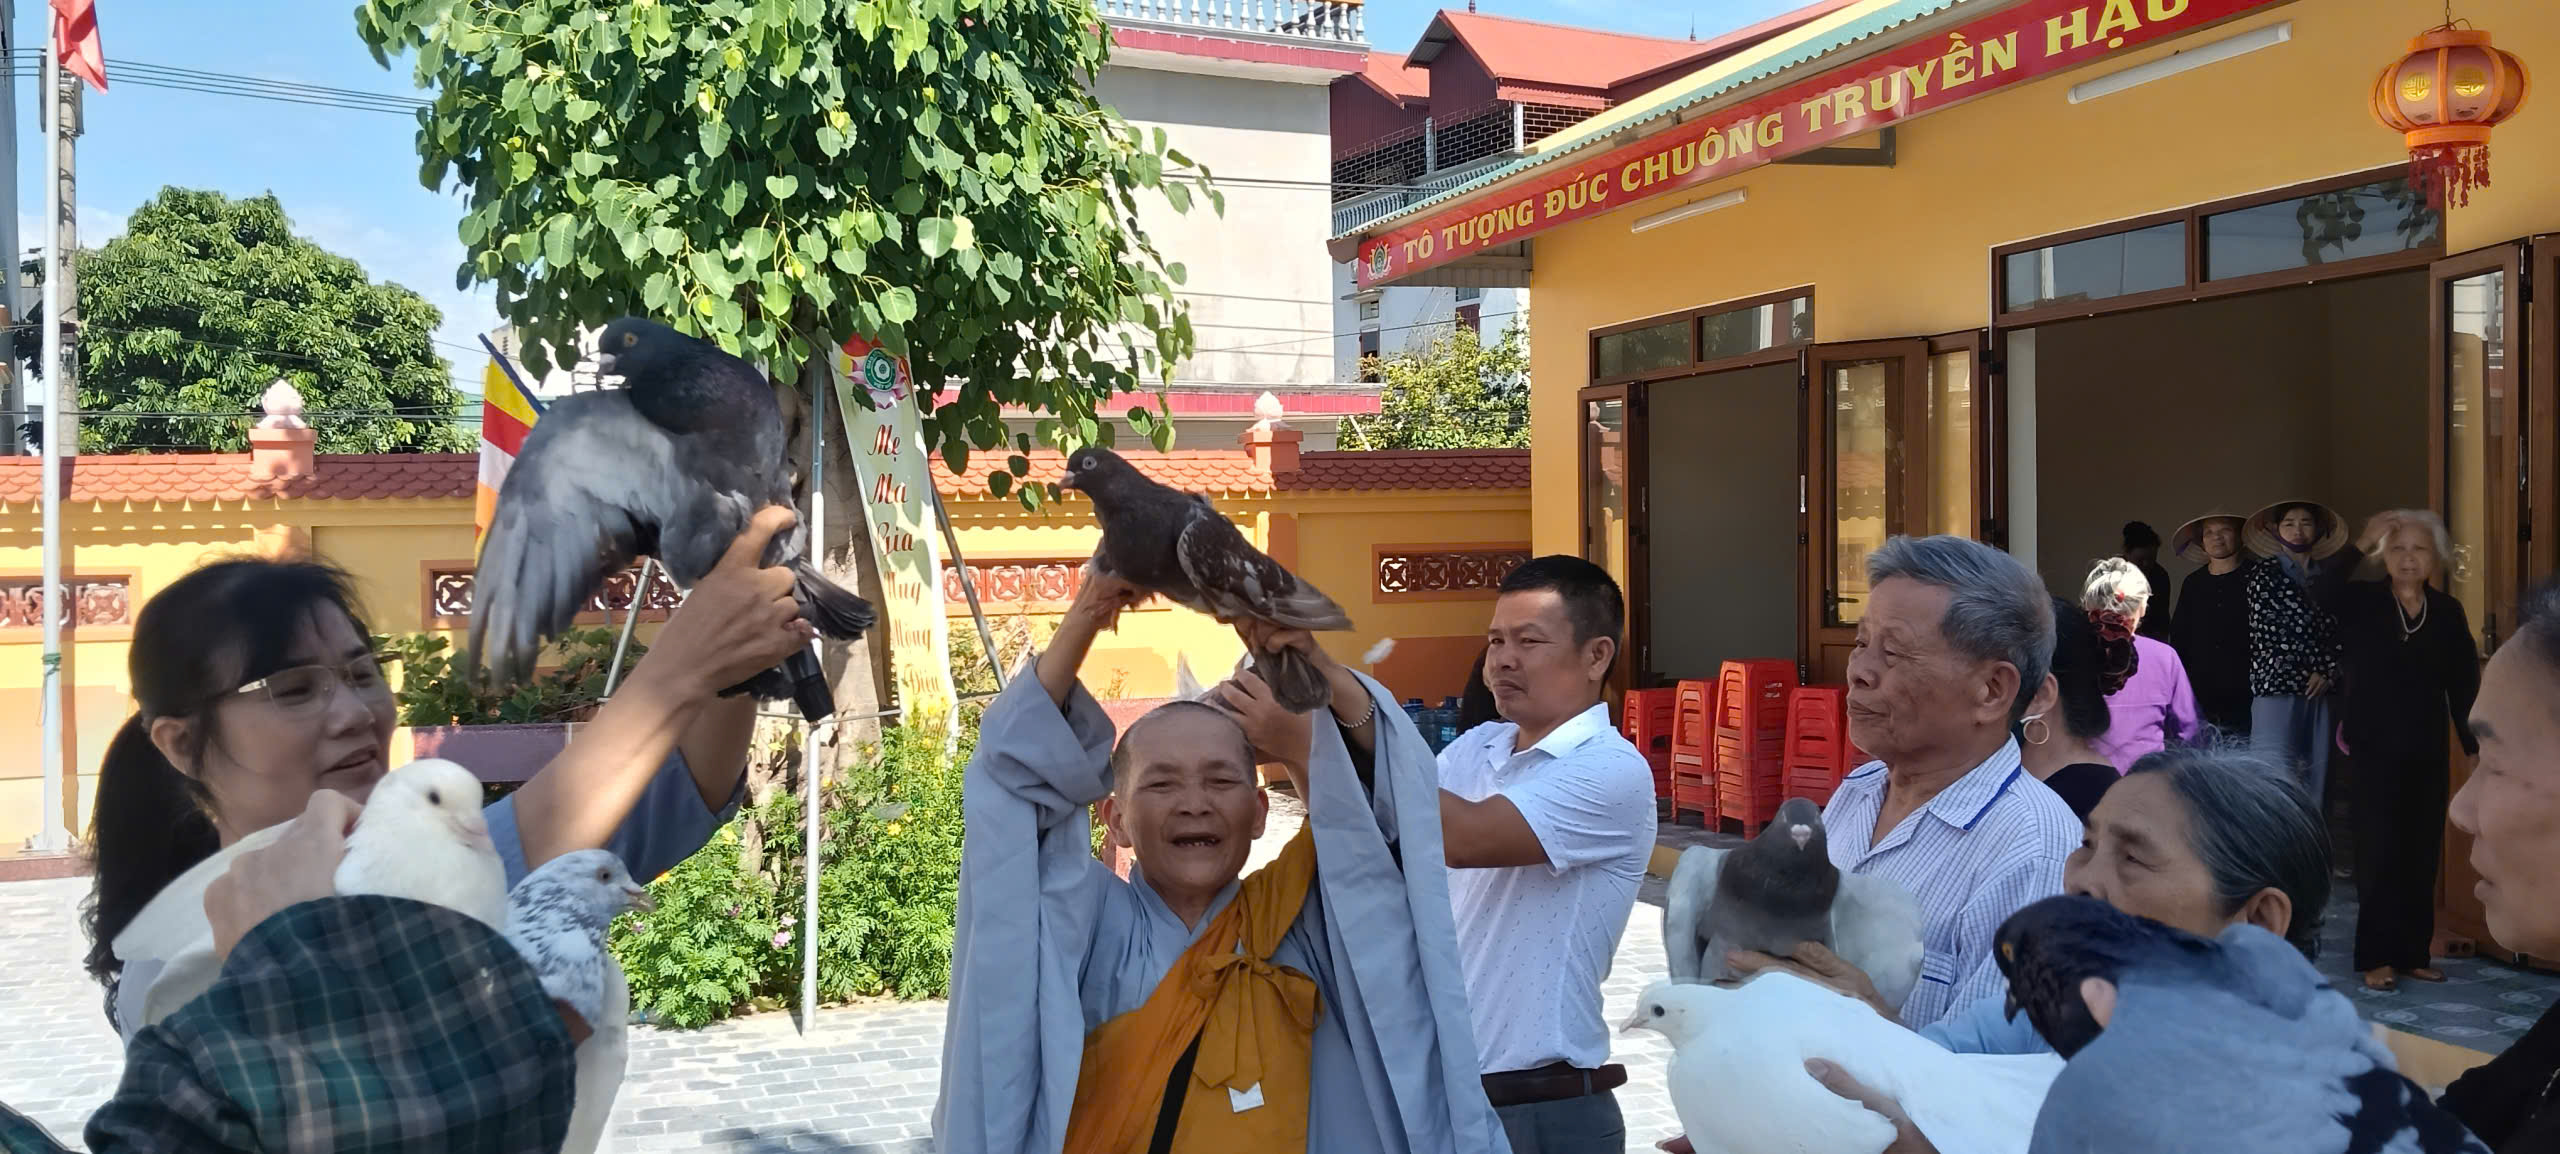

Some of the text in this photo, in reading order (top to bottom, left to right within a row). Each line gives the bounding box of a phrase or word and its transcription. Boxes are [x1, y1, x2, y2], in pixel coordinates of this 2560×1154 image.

[1403, 229, 1434, 264] TÔ
[1442, 199, 1534, 246] TƯỢNG
[1544, 172, 1609, 218] ĐÚC
[1621, 112, 1784, 192] CHUÔNG
[1801, 31, 2019, 133] TRUYỀN
[867, 424, 902, 462] Mẹ
[869, 473, 908, 504] Ma
[877, 521, 914, 557] Gia
